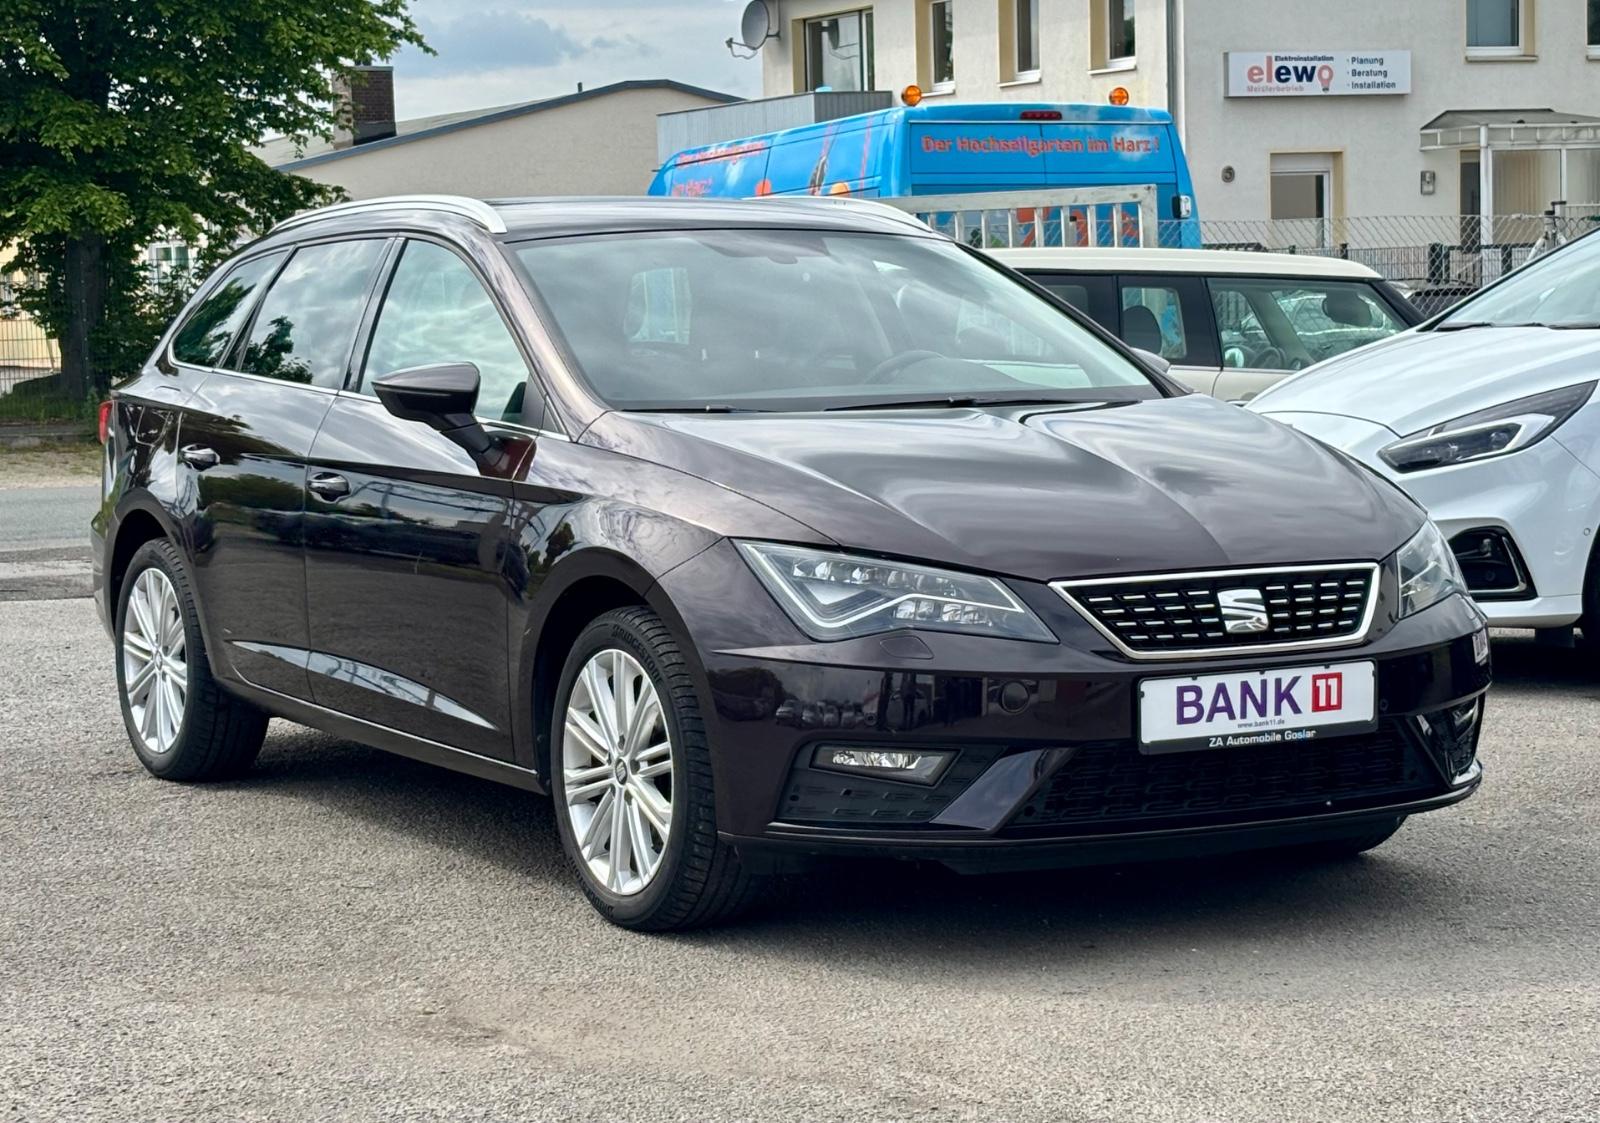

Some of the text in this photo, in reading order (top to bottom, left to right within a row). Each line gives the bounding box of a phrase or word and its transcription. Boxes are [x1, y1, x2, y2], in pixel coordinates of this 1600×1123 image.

[1351, 56, 1384, 66] Planung
[1351, 69, 1388, 78] Beratung
[1351, 81, 1396, 89] Installation
[921, 135, 952, 152] Der
[957, 135, 1083, 157] Hochseilgarten
[1087, 136, 1109, 152] im
[1176, 676, 1338, 725] BANK 11
[1237, 718, 1285, 729] www.bank11.de
[1209, 729, 1317, 748] ZA Automobile Goslar
